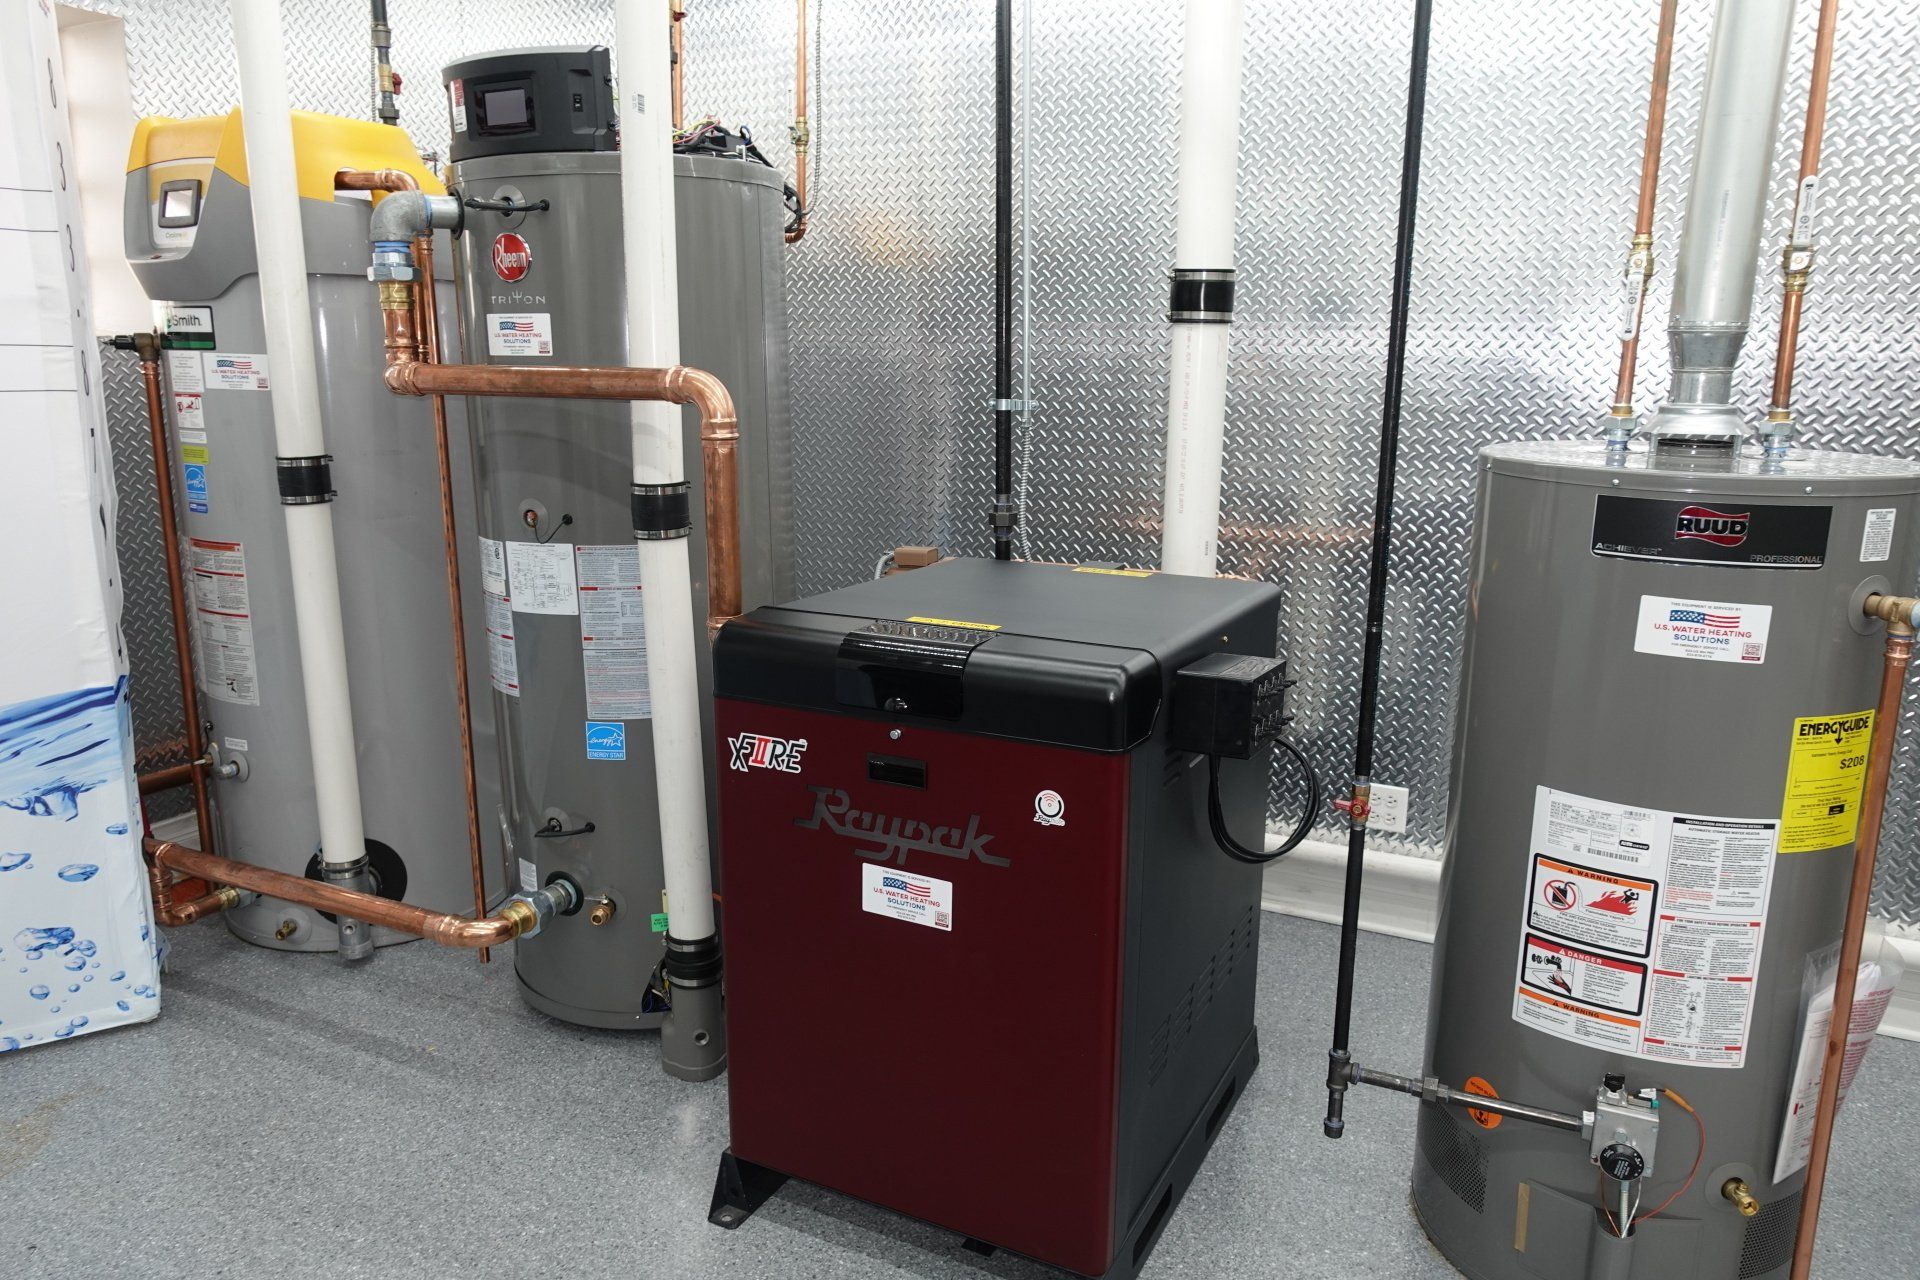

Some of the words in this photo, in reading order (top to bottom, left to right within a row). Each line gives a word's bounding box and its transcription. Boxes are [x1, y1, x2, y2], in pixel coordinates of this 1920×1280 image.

[494, 237, 527, 275] Rheem
[491, 289, 546, 305] TRITON
[173, 314, 201, 327] Smith
[1677, 517, 1748, 535] RUUD
[1750, 554, 1823, 564] PROFESSIONAL
[1654, 623, 1670, 632] U.S.
[1672, 625, 1706, 635] WATER
[1708, 629, 1752, 639] HEATING
[1674, 633, 1730, 645] SOLUTIONS
[794, 785, 1010, 867] Raypak
[1577, 870, 1619, 885] WARNING
[873, 887, 884, 895] U.S.
[886, 889, 909, 900] WATER
[910, 895, 941, 908] HEATING
[887, 897, 926, 911] SOLUTIONS
[1568, 951, 1602, 965] DANGER
[1563, 1003, 1600, 1019] WARNING
